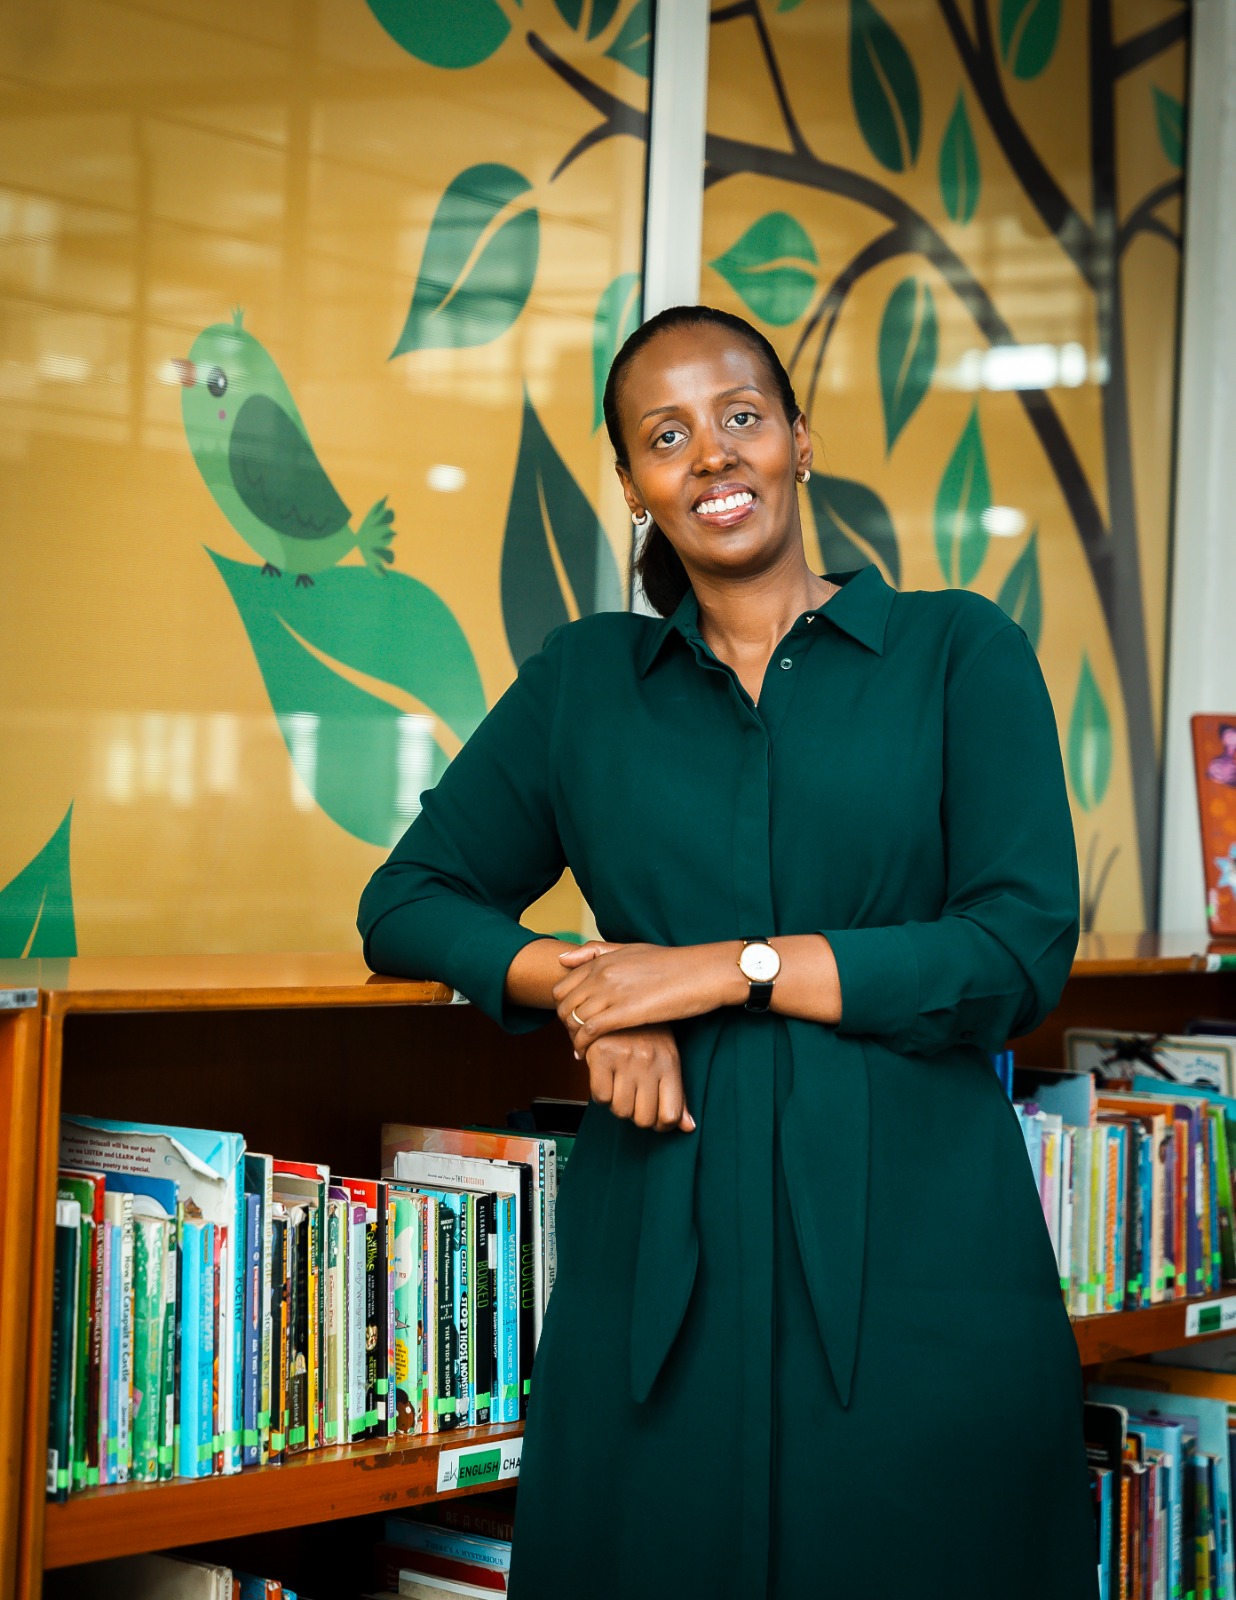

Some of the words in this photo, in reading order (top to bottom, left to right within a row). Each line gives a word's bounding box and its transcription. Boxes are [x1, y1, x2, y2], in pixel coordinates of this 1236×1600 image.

[84, 1148, 103, 1156] LISTEN
[115, 1152, 134, 1160] LEARN
[135, 1154, 151, 1163] about
[141, 1146, 156, 1154] guide
[102, 1162, 121, 1170] poetry
[130, 1165, 150, 1173] special.
[464, 1176, 485, 1186] CROSSOVER
[355, 1260, 364, 1284] Emily
[478, 1260, 489, 1308] BOOKED
[508, 1234, 516, 1311] WHIZZIWIG
[522, 1244, 535, 1309] BOOKED
[123, 1282, 130, 1293] to
[235, 1277, 243, 1321] POETRY
[122, 1296, 130, 1339] Catapult
[355, 1286, 364, 1330] Windsnap
[460, 1296, 468, 1328] STOP
[460, 1328, 468, 1361] THOSE
[460, 1461, 499, 1479] ENGLISH
[464, 1515, 470, 1526] A
[426, 1539, 454, 1554] THERE'S
[462, 1550, 504, 1566] MYSTERIOUS
